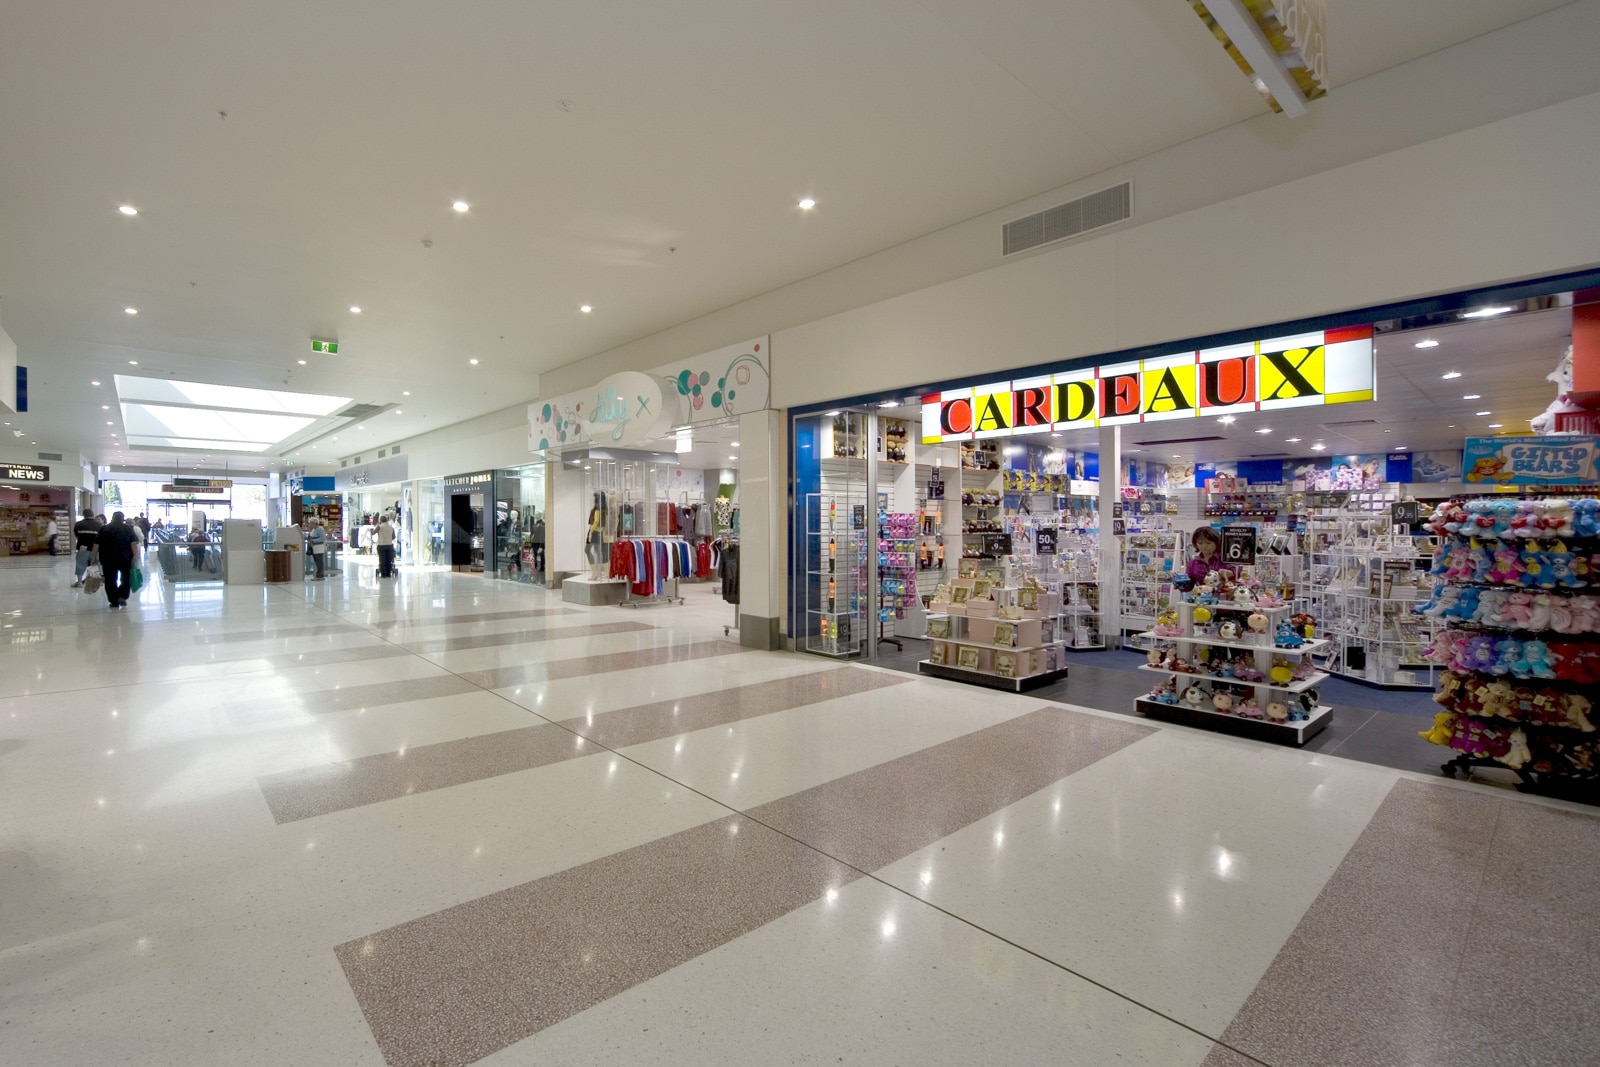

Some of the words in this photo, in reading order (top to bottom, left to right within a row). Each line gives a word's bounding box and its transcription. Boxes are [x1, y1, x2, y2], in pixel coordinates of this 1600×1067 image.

[941, 345, 1325, 434] CARDEAUX
[1510, 446, 1588, 461] GIFTED
[1513, 459, 1581, 474] BEARS
[8, 469, 45, 480] NEWS
[470, 474, 492, 485] JONES
